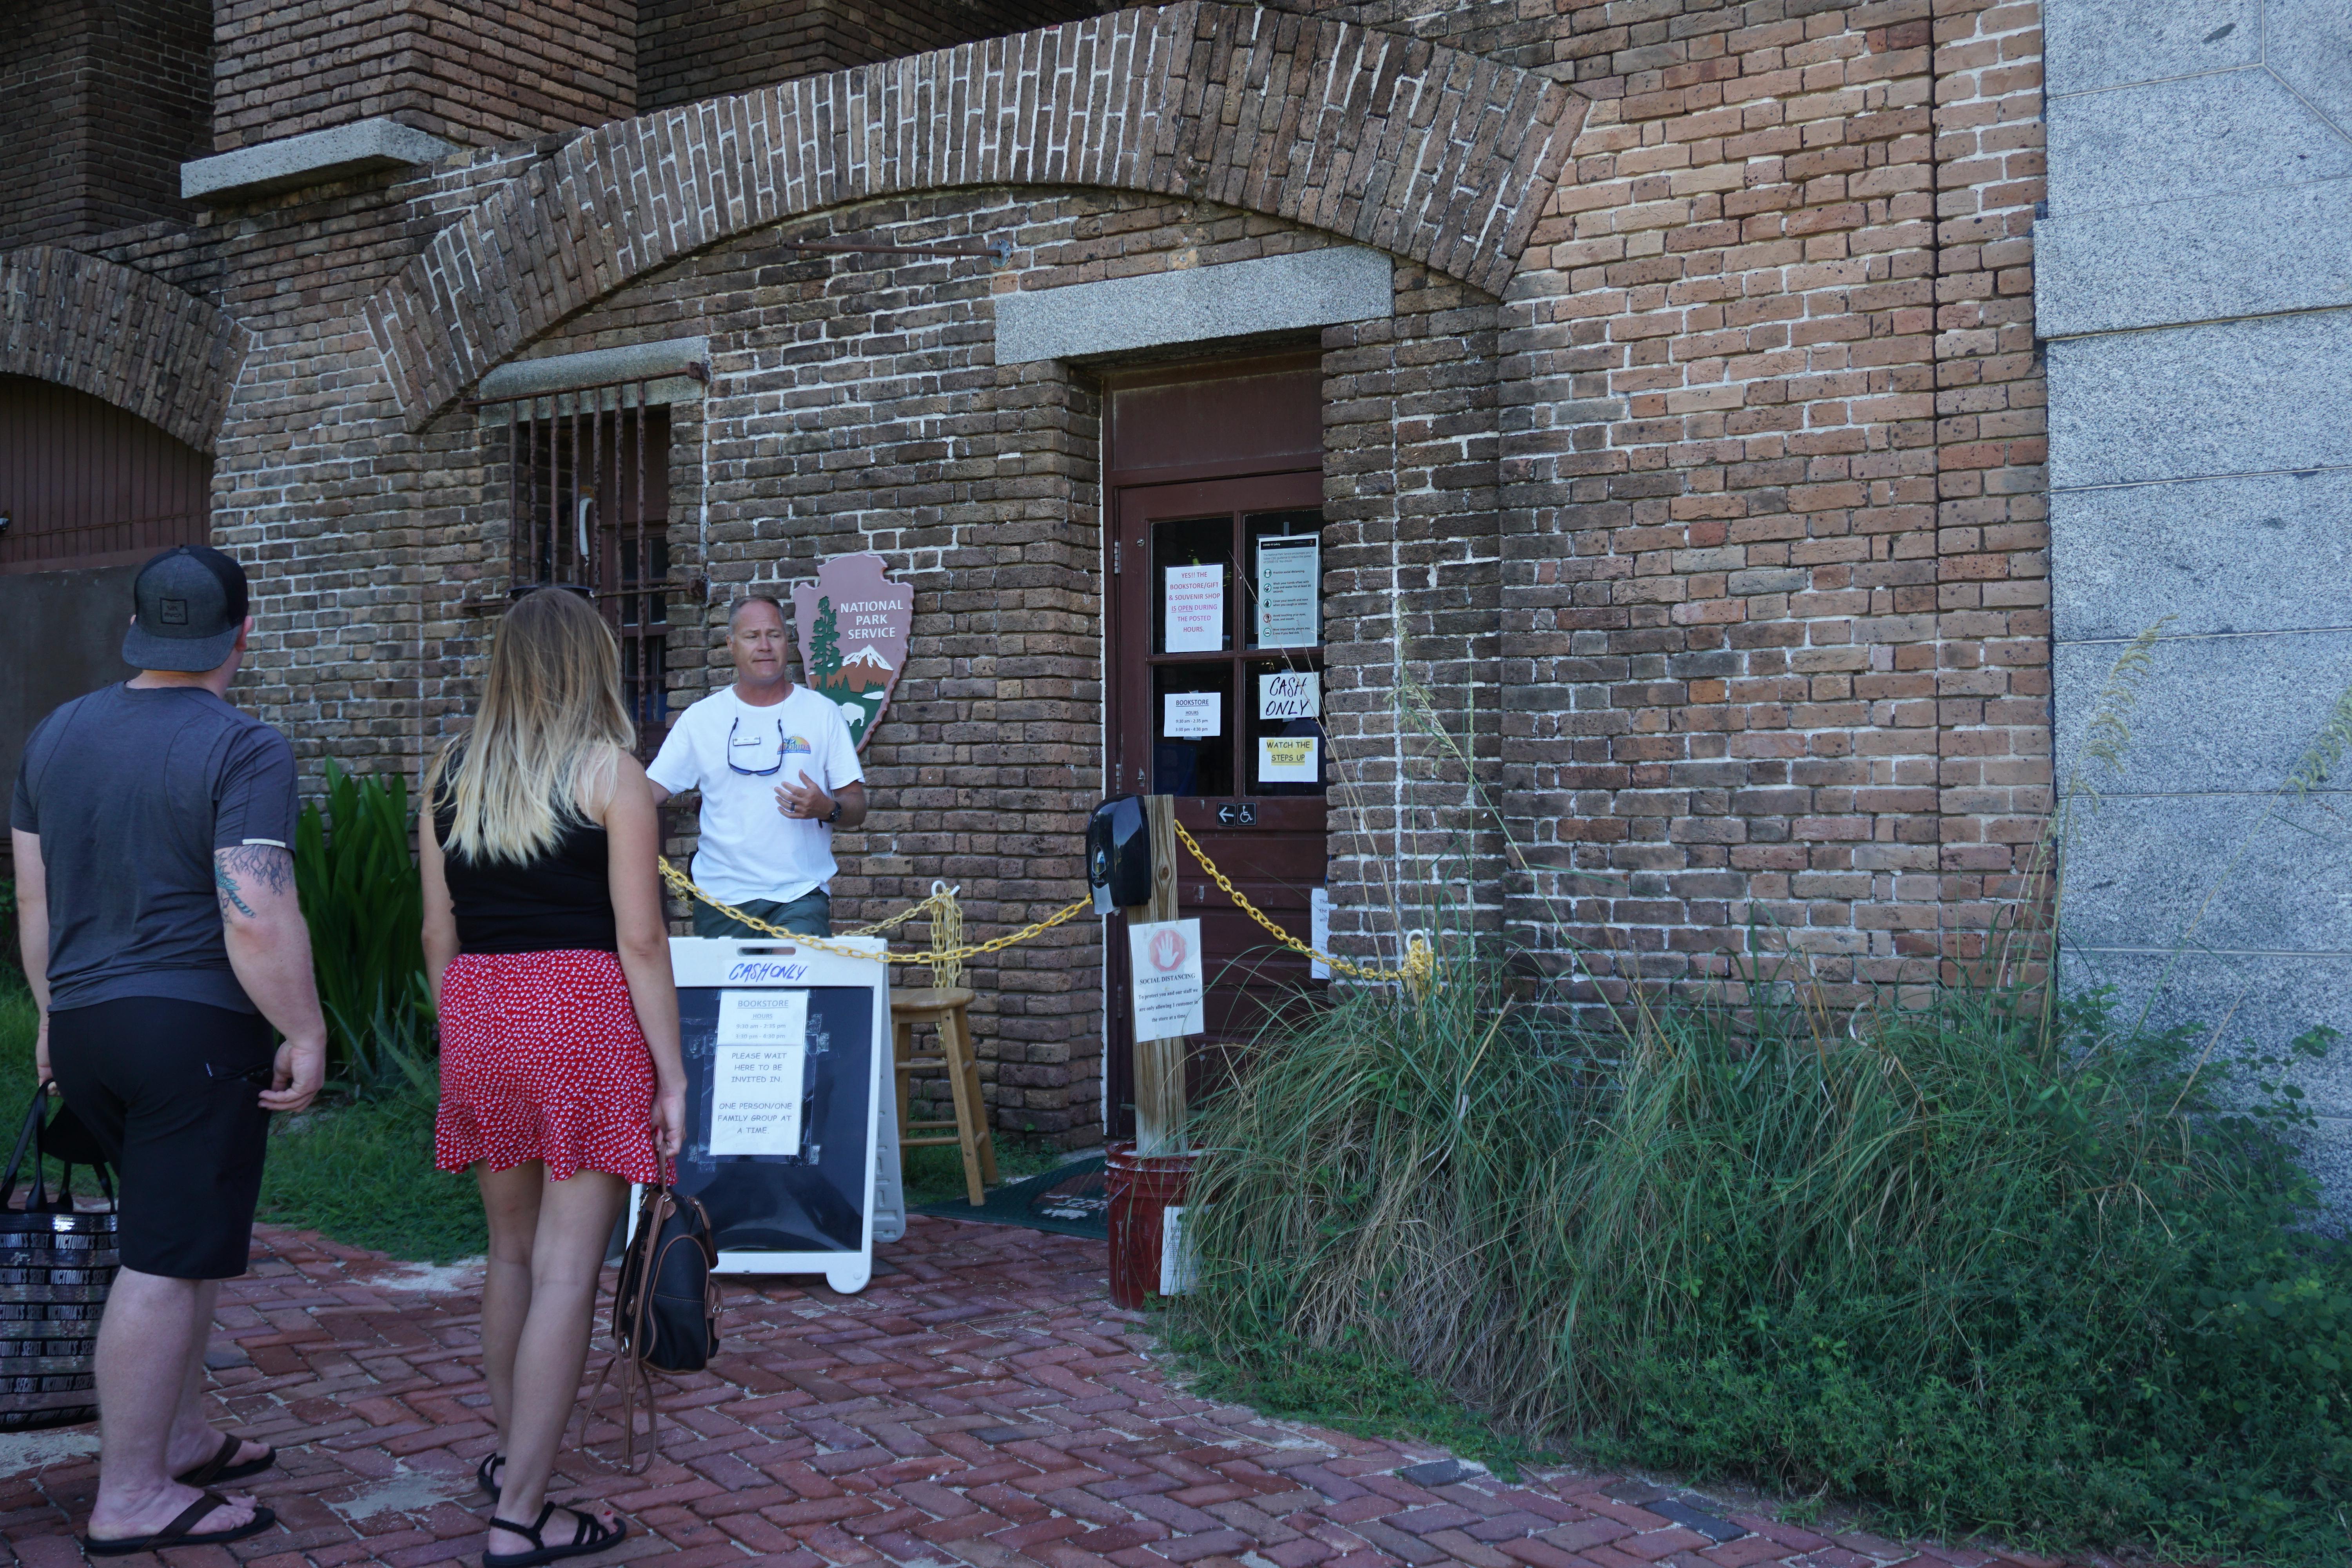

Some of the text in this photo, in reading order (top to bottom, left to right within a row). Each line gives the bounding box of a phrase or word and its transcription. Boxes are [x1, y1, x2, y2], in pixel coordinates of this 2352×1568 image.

[841, 600, 904, 613] NATIONAL
[856, 614, 887, 625] PARK
[848, 627, 895, 639] SERVICE
[1270, 676, 1307, 697] CASH
[1266, 699, 1310, 716] ONLY
[729, 963, 808, 982] CASH ONLY
[1161, 973, 1195, 982] DISTANCING
[55, 1234, 96, 1249] VICTORIA'S
[50, 1269, 91, 1285] VICTORIA'S
